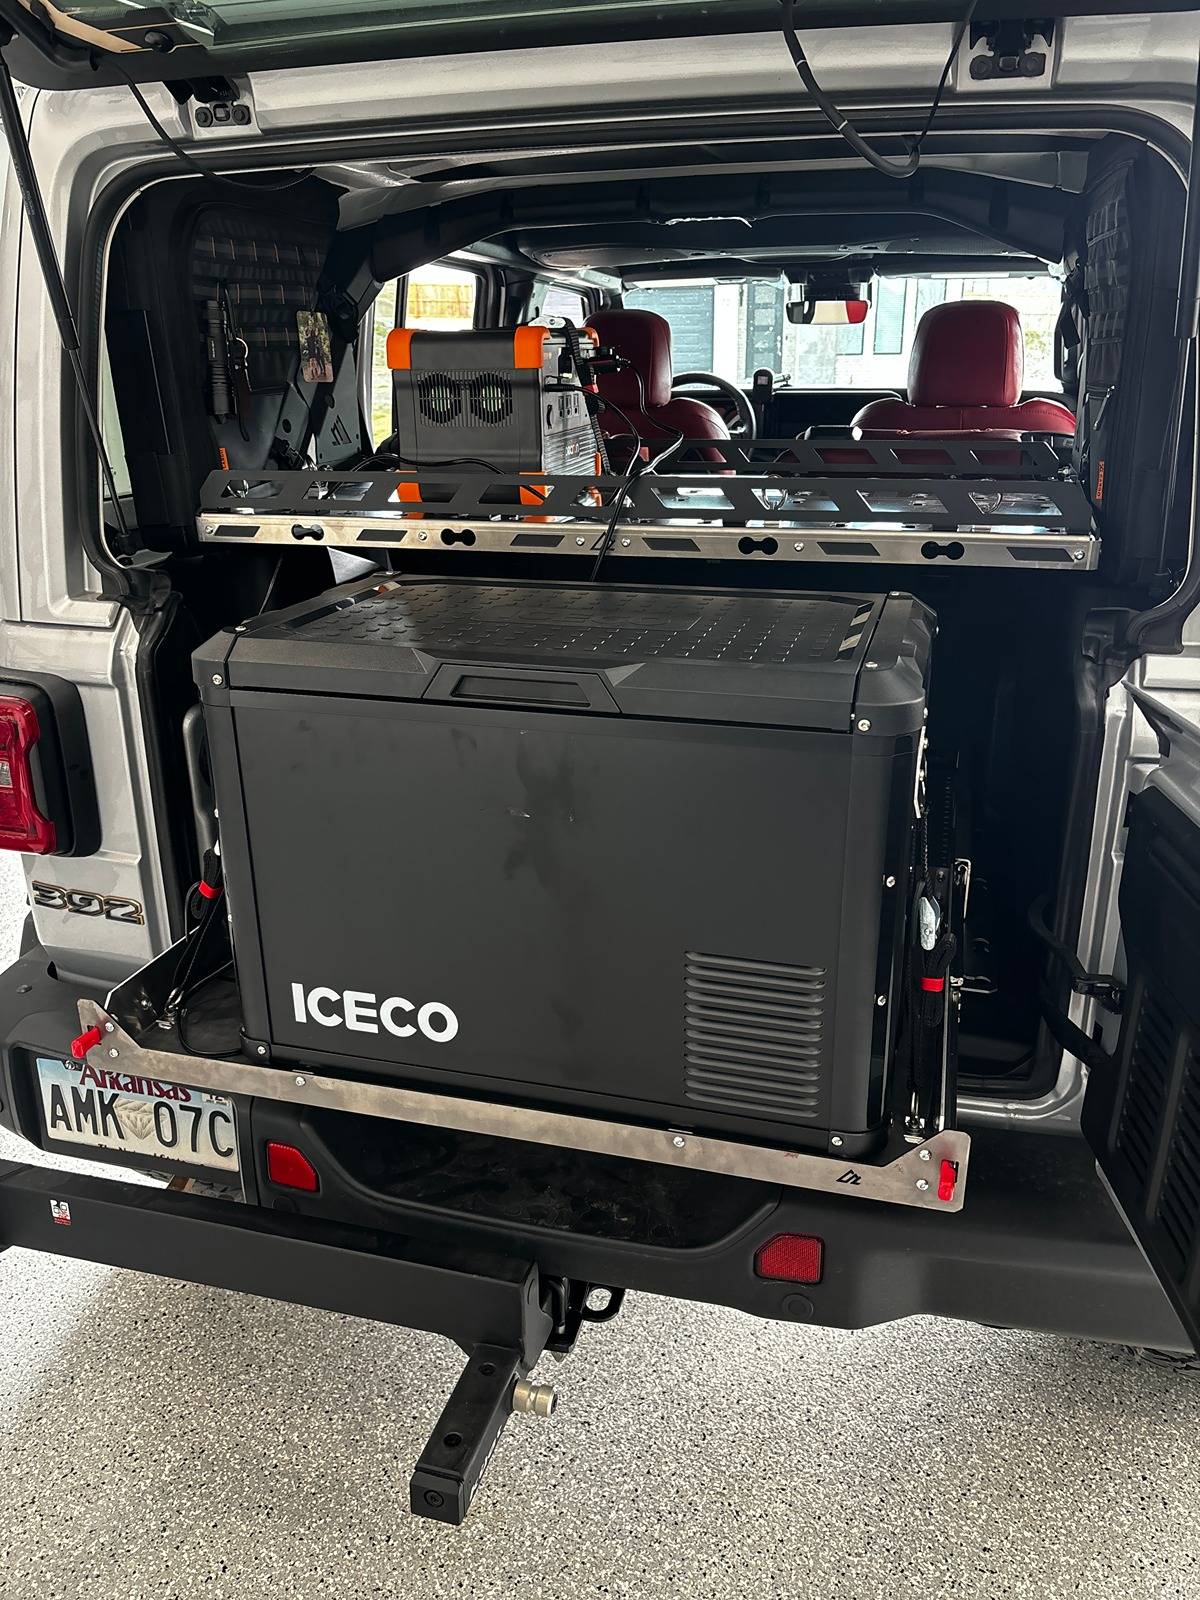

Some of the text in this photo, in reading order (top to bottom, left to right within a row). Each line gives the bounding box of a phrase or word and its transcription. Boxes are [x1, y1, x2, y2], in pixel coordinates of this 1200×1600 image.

[32, 880, 145, 926] 392
[291, 982, 459, 1043] ICECO
[79, 1064, 192, 1103] Arkansas
[50, 1083, 125, 1140] AMK
[153, 1101, 235, 1158] 07C
